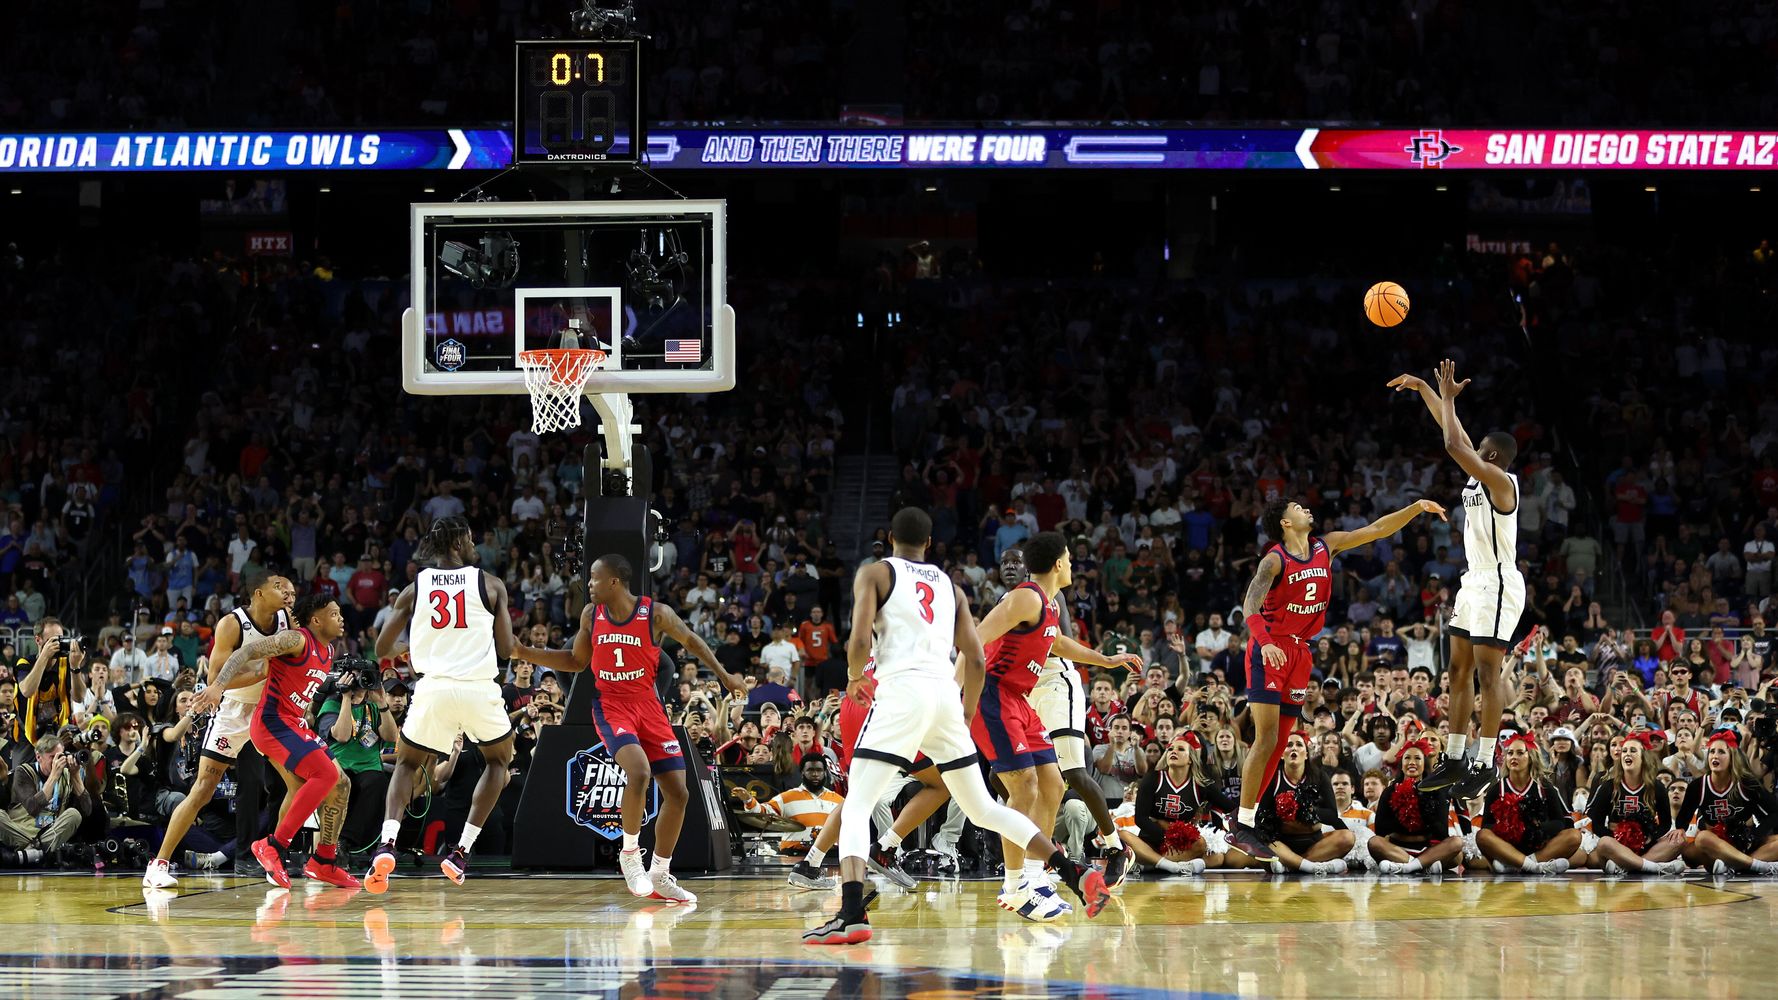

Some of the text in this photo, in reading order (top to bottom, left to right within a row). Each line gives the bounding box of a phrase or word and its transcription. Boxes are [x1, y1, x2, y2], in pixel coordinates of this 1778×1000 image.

[0, 135, 380, 167] ORIDA ATLANTIC OWLS
[702, 136, 1046, 162] AND THEN THERE WERE FOUR
[1485, 134, 1778, 165] SAN DIEGO STATE AZ
[251, 237, 287, 249] HTX
[442, 347, 460, 355] FINAL
[443, 354, 461, 362] FOUR
[431, 574, 466, 586] MENSAH
[1288, 568, 1328, 584] FLORIDA
[1305, 582, 1317, 601] 2
[429, 589, 468, 629] 31
[915, 581, 934, 624] 3
[1287, 602, 1327, 614] ATLANTIC
[598, 634, 642, 647] FLORIDA
[812, 631, 822, 647] 5
[613, 648, 625, 667] 1
[599, 668, 645, 681] ATLANTIC
[584, 763, 628, 786] FINA
